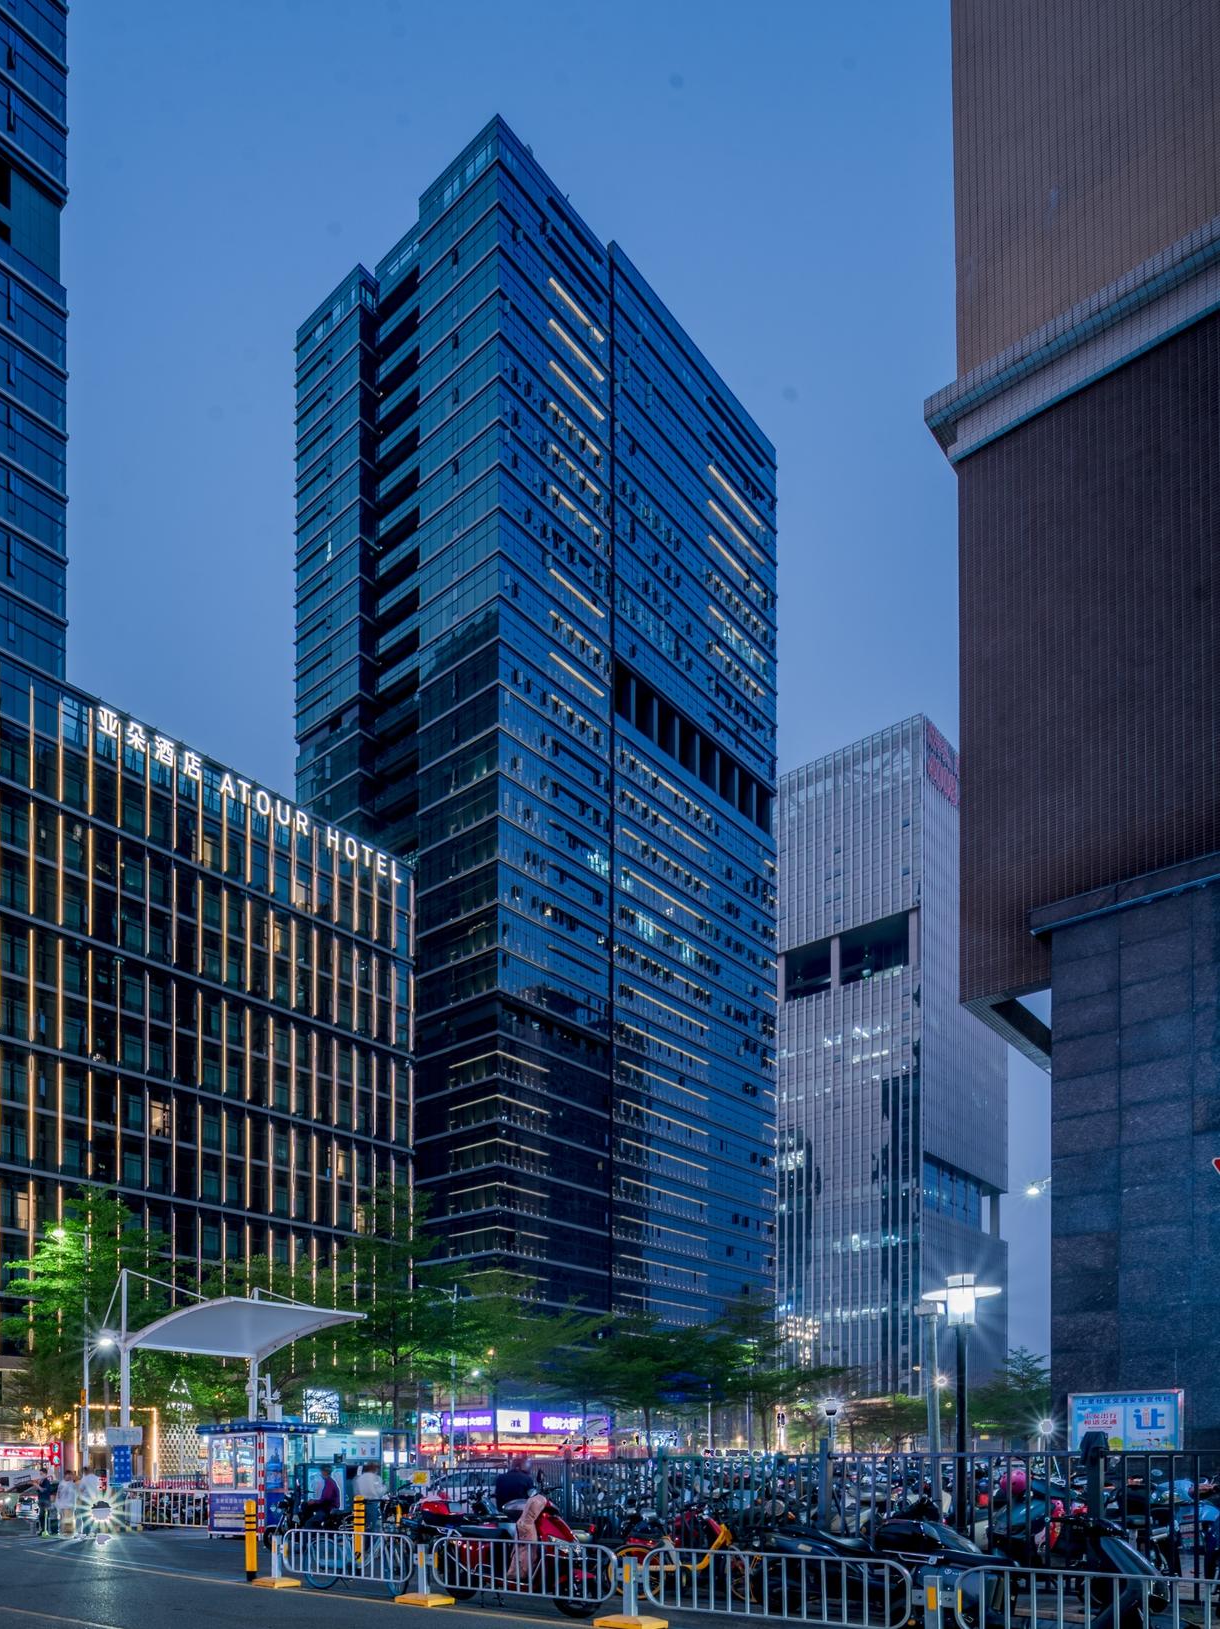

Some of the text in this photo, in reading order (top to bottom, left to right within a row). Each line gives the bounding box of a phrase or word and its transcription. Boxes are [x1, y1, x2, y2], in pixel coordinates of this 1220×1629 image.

[98, 706, 402, 884] 亚朵酒店 ATOUR HOTEL
[1133, 1408, 1165, 1430] 让
